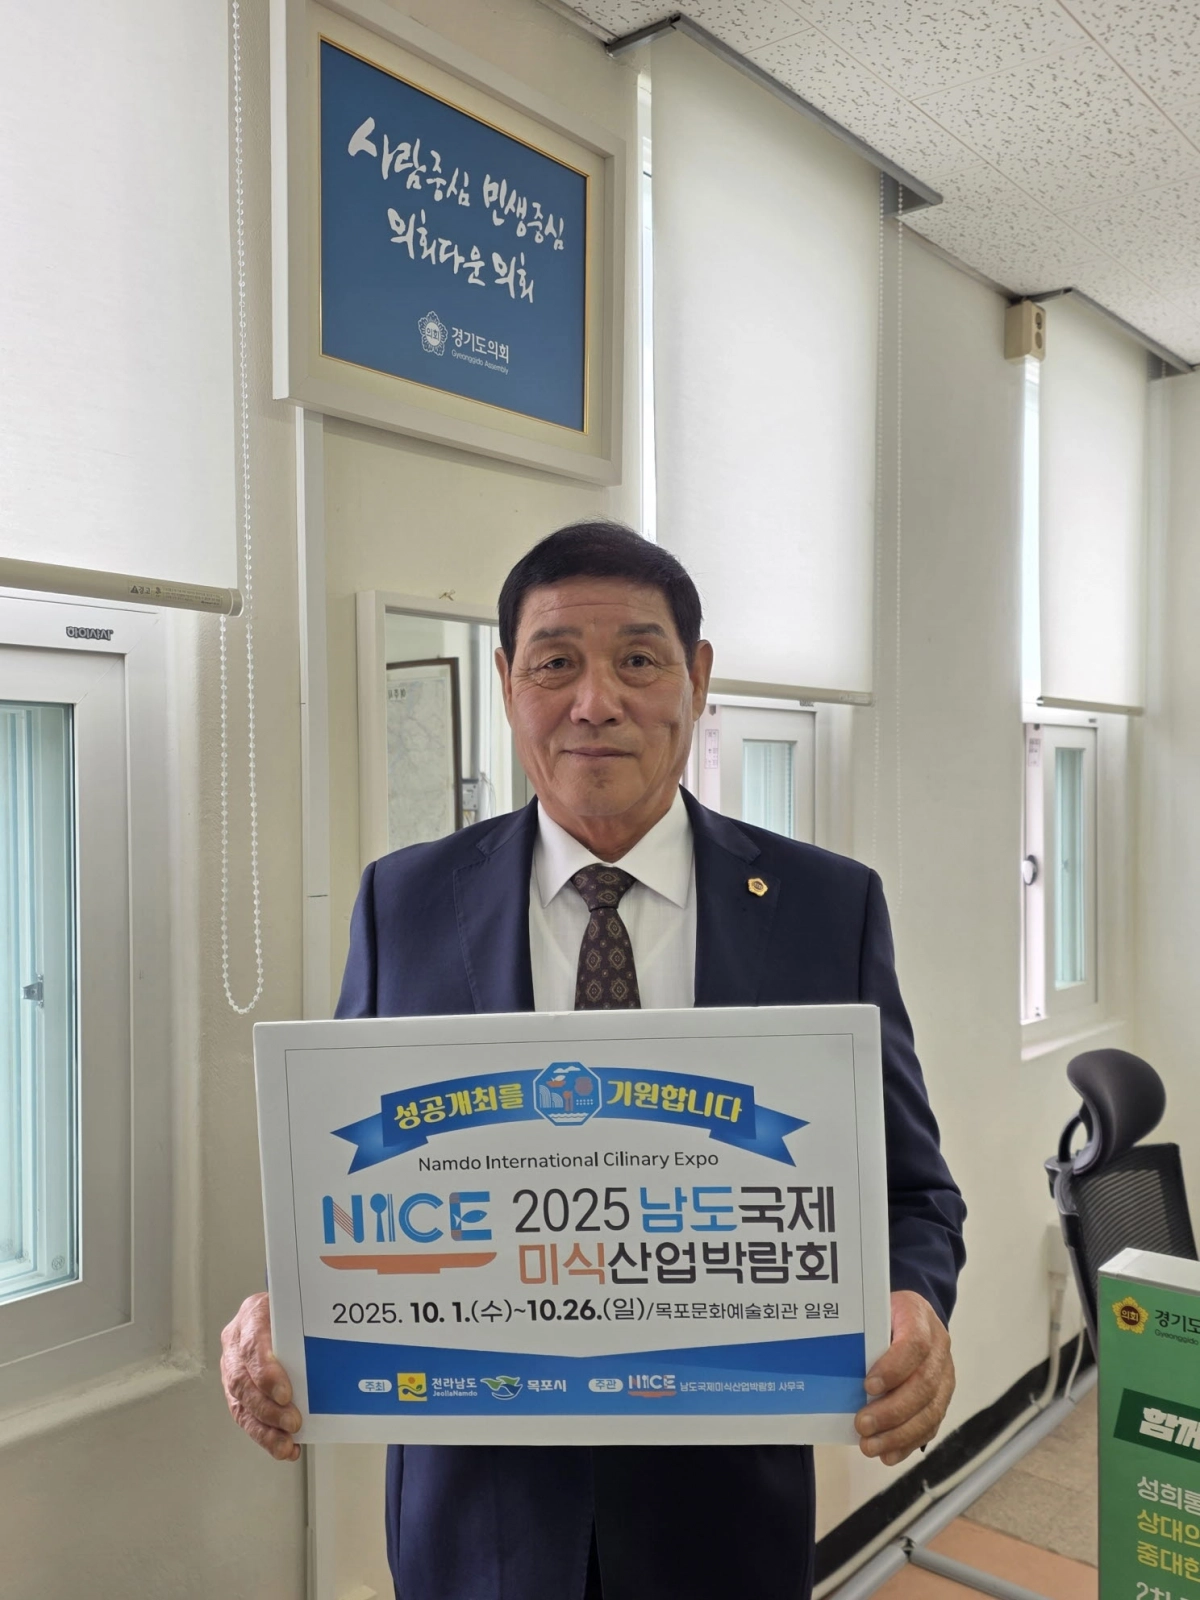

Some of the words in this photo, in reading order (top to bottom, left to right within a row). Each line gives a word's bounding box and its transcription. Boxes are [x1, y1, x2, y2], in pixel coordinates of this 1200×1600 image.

[348, 116, 471, 207] 사람중심
[483, 173, 565, 250] 민생중심
[387, 208, 486, 286] 의회다운
[492, 252, 534, 303] 의회
[426, 327, 440, 341] 의회
[451, 326, 509, 364] 경기도의회
[451, 349, 484, 366] Gyeonggido
[484, 360, 509, 375] Assembly
[66, 626, 112, 641] 하이샤시
[394, 1082, 524, 1130] 성공개최를
[606, 1080, 743, 1123] 기원합니다
[419, 1156, 481, 1171] Namdo
[486, 1152, 599, 1169] International
[603, 1151, 669, 1169] Cilinary
[674, 1151, 719, 1168] Expo
[322, 1191, 493, 1244] NICE
[512, 1187, 630, 1233] 2025
[639, 1185, 836, 1233] 남도국제
[518, 1241, 839, 1285] 미식산업박람회
[332, 1302, 403, 1324] 2025.
[804, 1302, 840, 1320] 일원
[1121, 1309, 1139, 1322] 의회
[1154, 1328, 1199, 1346] Gyeonggido
[364, 1380, 386, 1392] 주최
[432, 1377, 478, 1390] 전라남도
[527, 1379, 567, 1393] 목포시
[595, 1379, 617, 1390] 주관
[628, 1374, 676, 1390] NICE
[680, 1381, 776, 1393] 남도국제미식산업박람회
[778, 1380, 805, 1392] 사무국
[432, 1389, 478, 1398] JeollaNamdo
